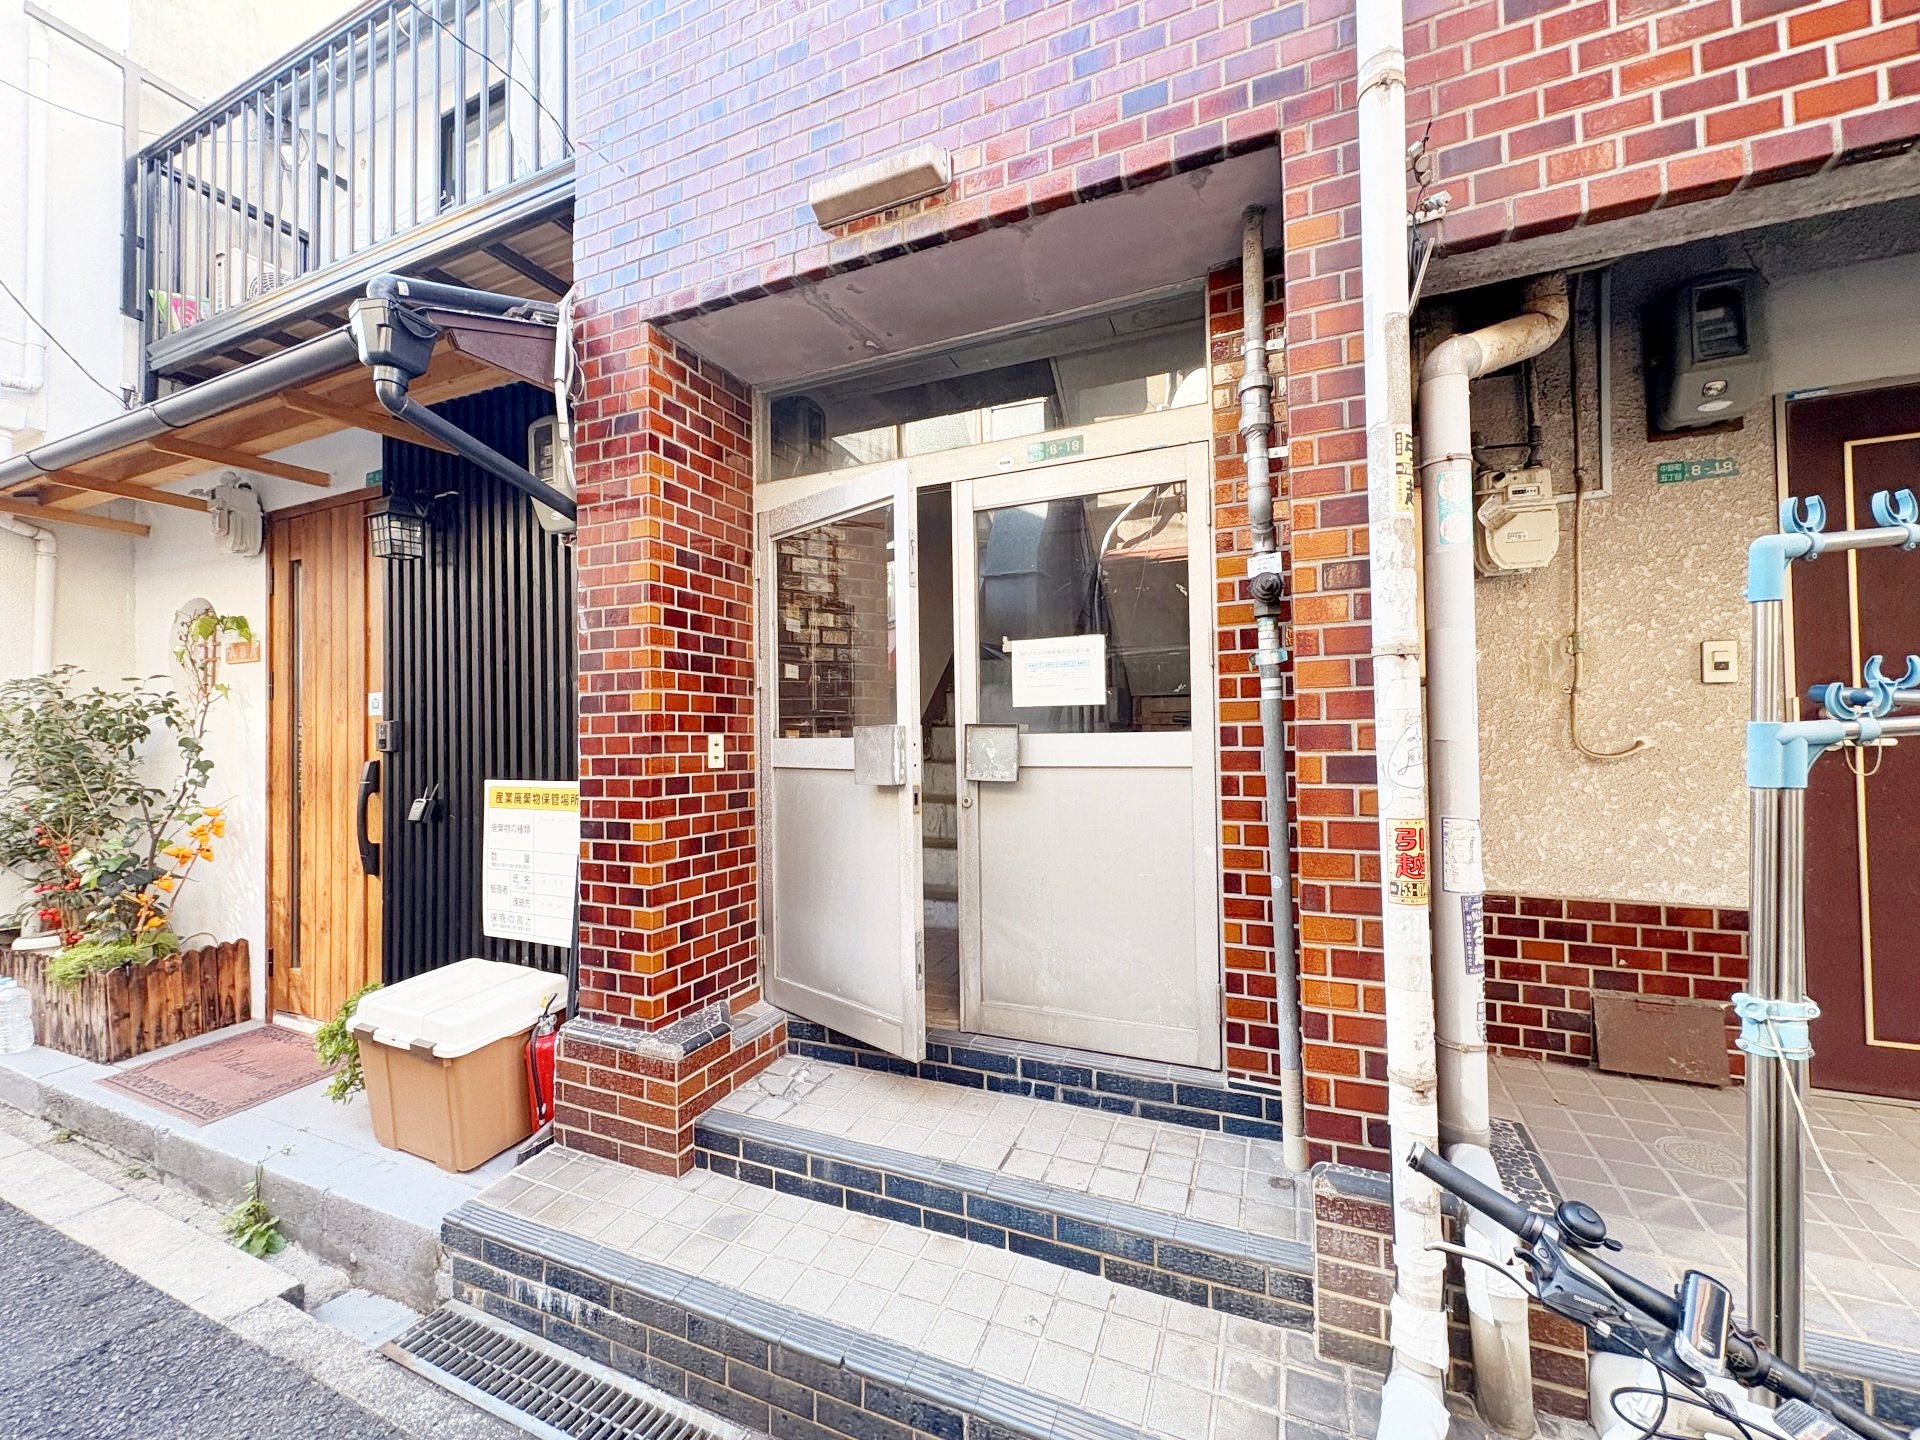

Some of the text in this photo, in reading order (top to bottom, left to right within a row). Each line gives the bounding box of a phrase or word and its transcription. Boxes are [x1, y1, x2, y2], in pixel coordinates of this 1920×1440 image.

[1050, 440, 1080, 455] 8-18
[1691, 461, 1733, 476] 8-18
[495, 791, 579, 807] 産業廃棄物保管場所
[491, 823, 531, 834] 廃棄物の種類
[1394, 827, 1426, 880] 引越
[1573, 1294, 1608, 1311] SHIMANO
